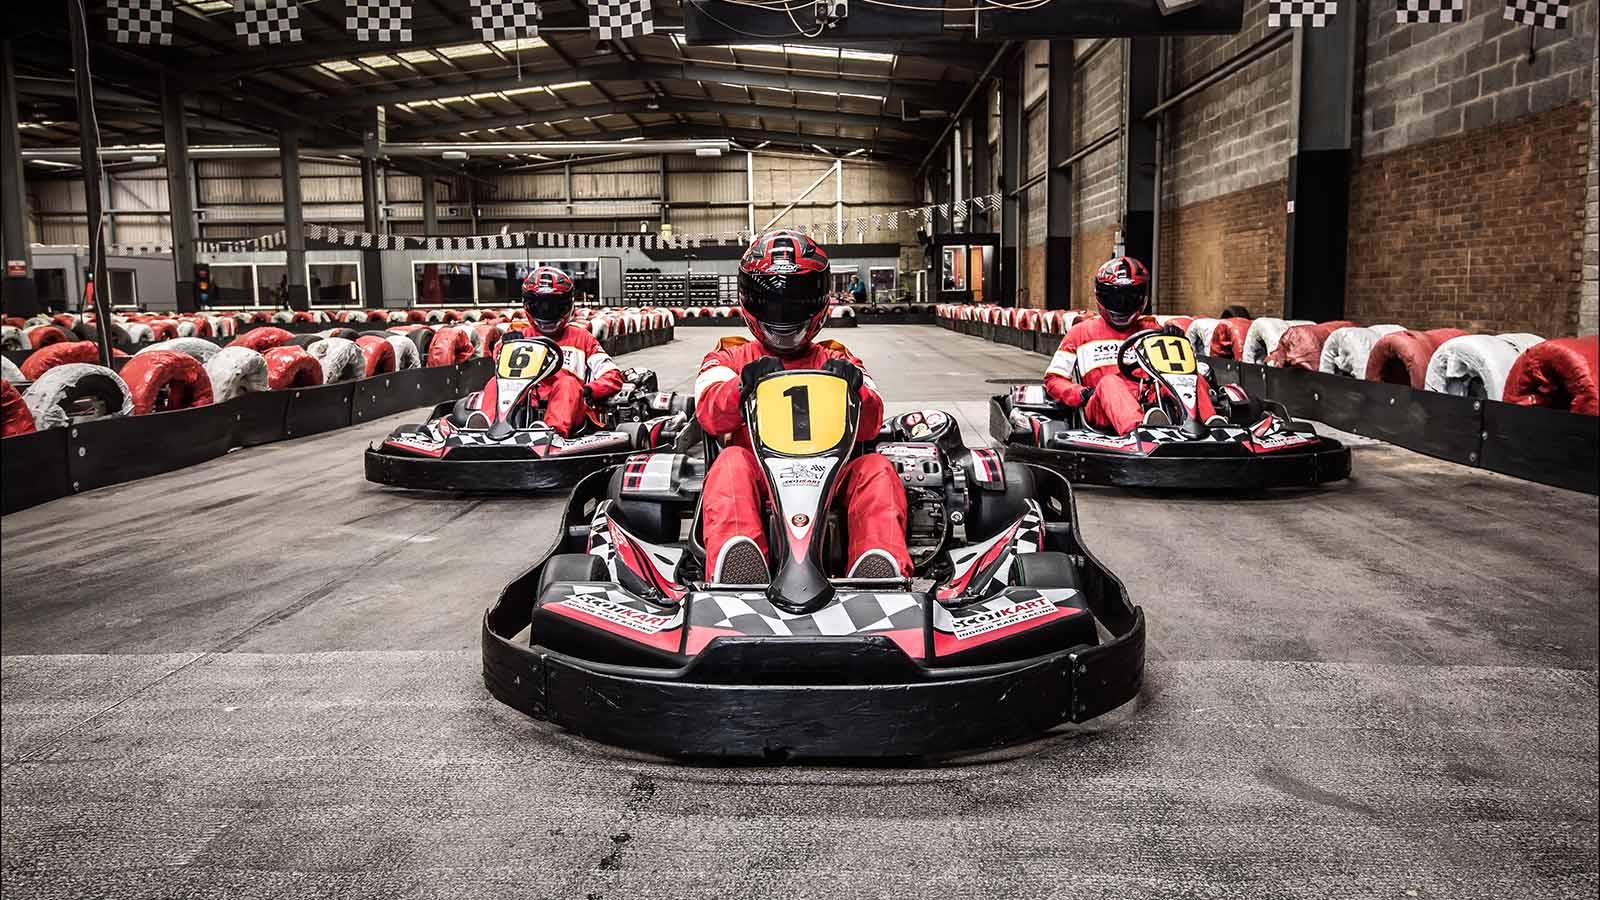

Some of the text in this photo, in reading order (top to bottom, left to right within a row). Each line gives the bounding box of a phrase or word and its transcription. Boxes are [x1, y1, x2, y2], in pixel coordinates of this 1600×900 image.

[508, 345, 534, 369] 6
[1151, 339, 1186, 361] 11
[783, 385, 811, 441] 1
[958, 607, 1055, 637] INDOOR KART RACING
